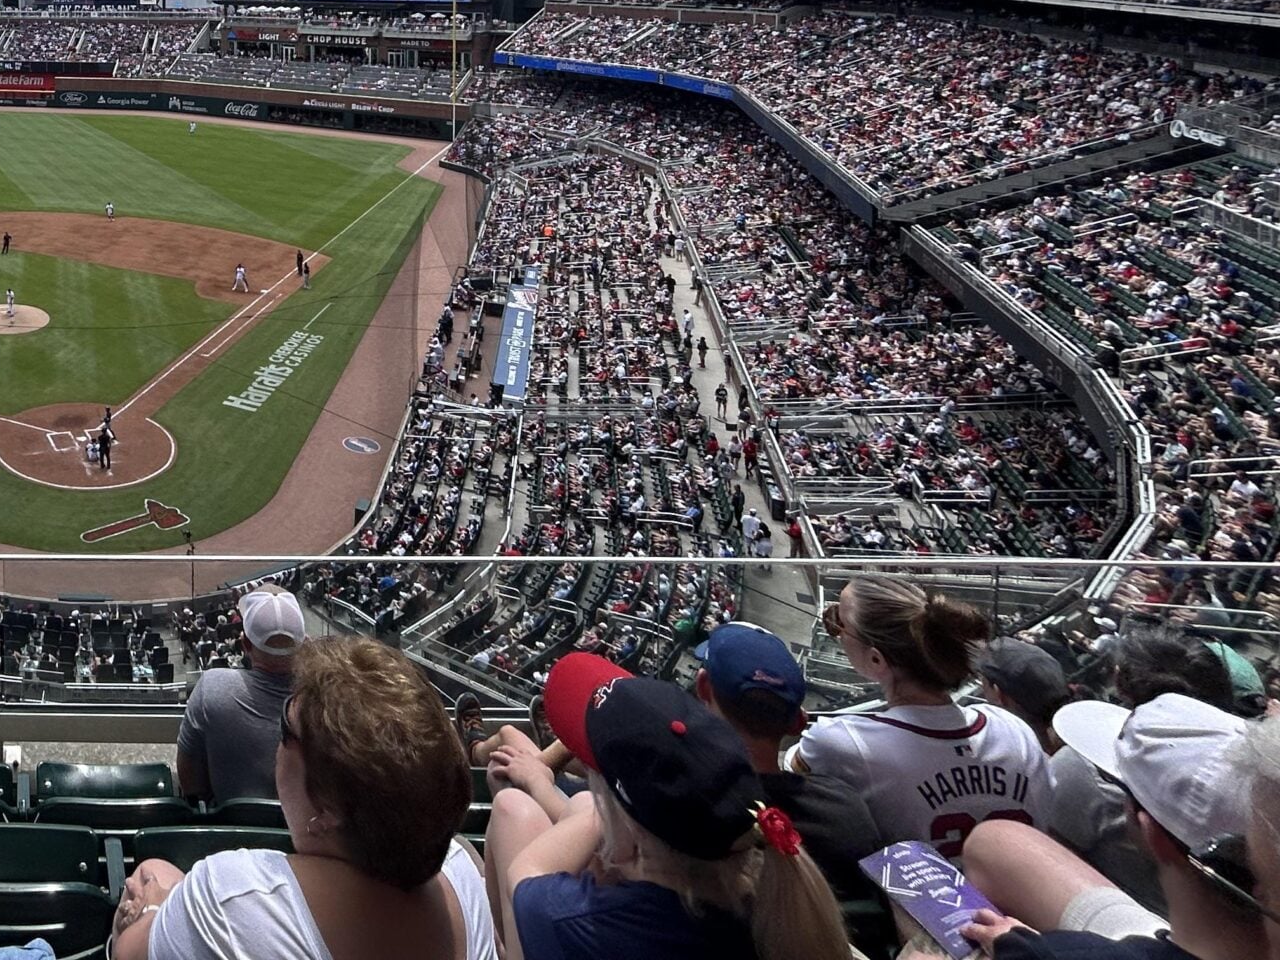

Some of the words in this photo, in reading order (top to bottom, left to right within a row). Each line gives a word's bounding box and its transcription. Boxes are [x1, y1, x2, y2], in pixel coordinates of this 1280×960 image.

[258, 33, 280, 41] LIGHT
[307, 35, 332, 44] CHOP
[335, 36, 368, 46] HOUSE
[64, 92, 83, 102] Ford
[106, 97, 130, 106] Georgia
[131, 97, 150, 106] Power
[268, 330, 309, 363] CHEROKEE
[284, 333, 325, 367] CASINOS
[916, 765, 1007, 811] HARRIS
[1012, 773, 1029, 803] II
[930, 808, 1034, 858] 2
[899, 860, 930, 873] Stream
